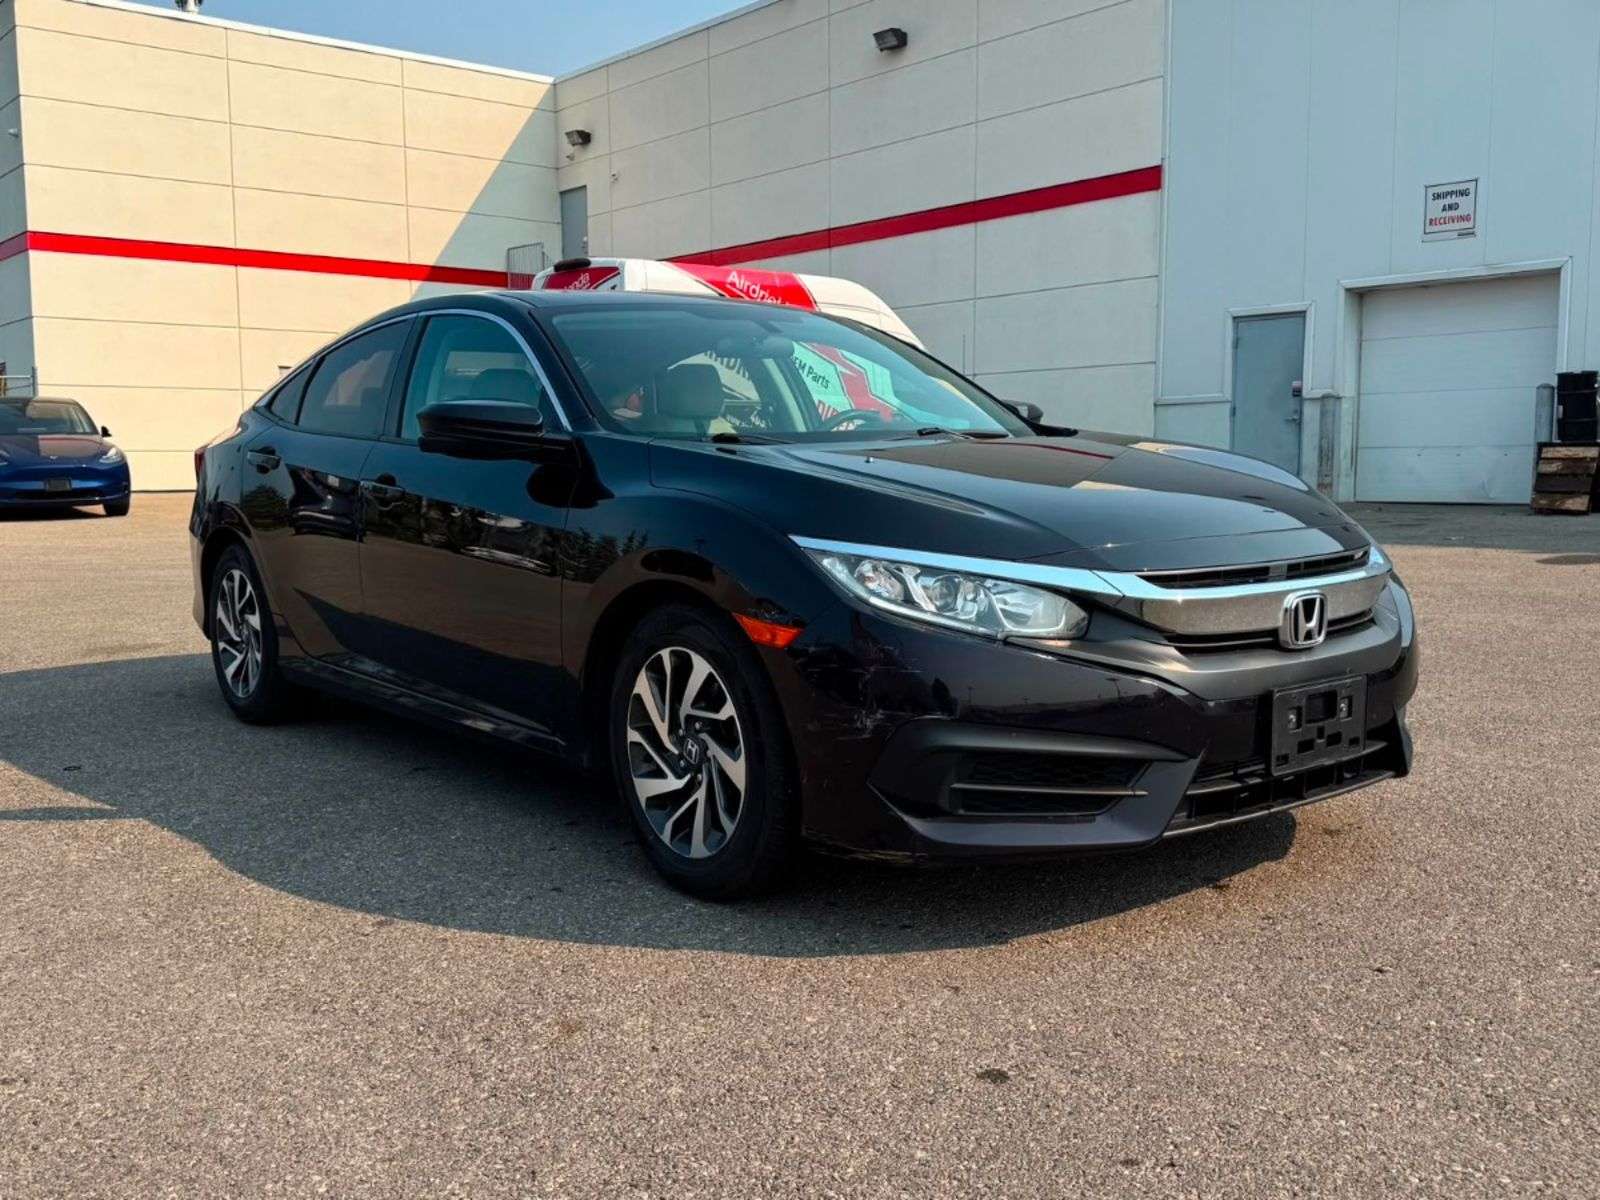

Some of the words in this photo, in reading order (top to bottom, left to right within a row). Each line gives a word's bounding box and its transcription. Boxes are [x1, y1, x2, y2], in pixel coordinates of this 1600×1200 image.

[1431, 188, 1471, 201] SHIPPING
[1441, 202, 1460, 212] AND
[1428, 214, 1472, 226] RECEIVING
[806, 365, 831, 389] Parts
